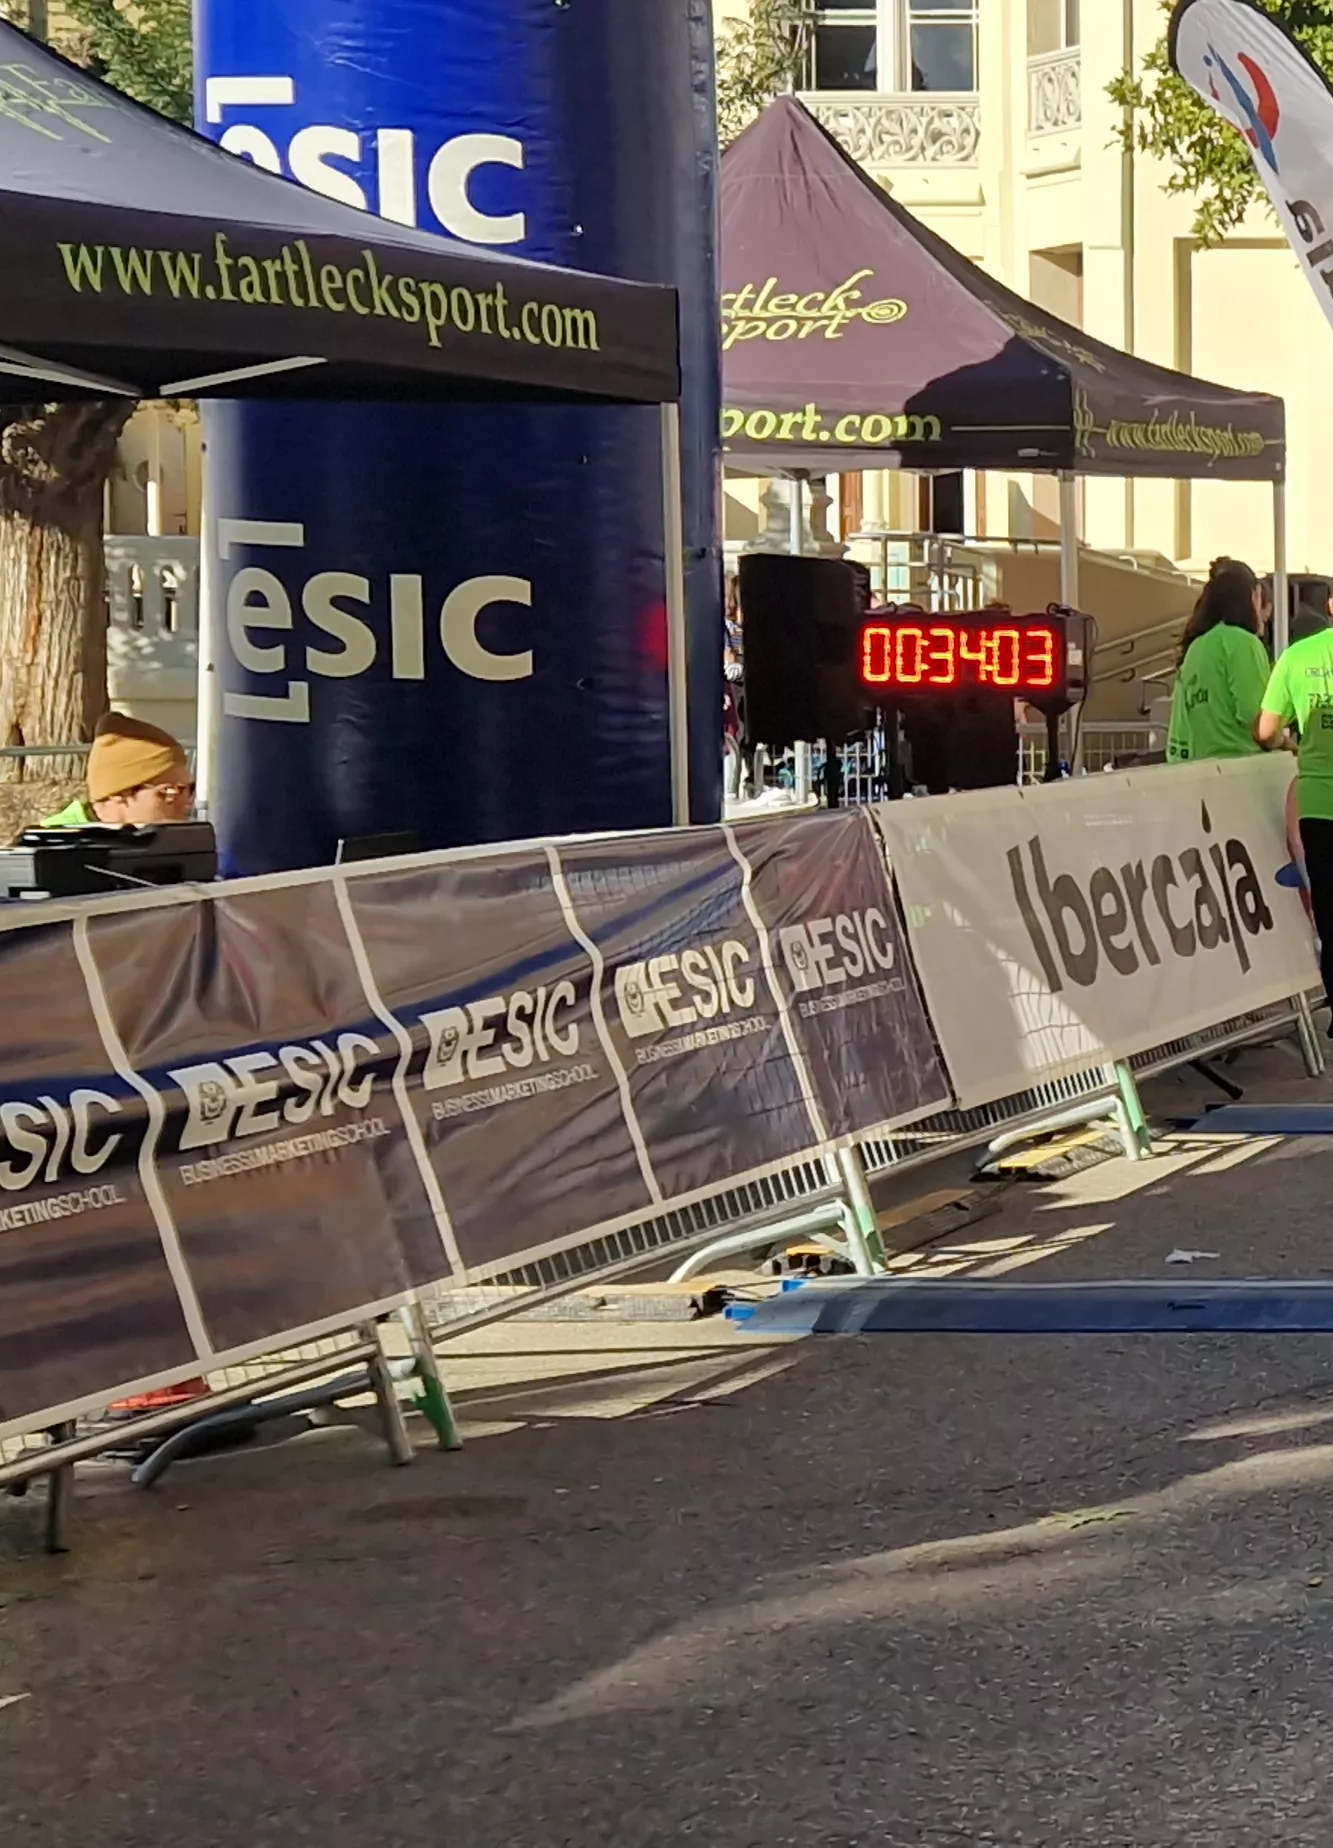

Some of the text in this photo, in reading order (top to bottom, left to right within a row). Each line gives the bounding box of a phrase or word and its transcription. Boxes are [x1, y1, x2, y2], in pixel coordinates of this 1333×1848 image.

[56, 232, 601, 350] www.fartlecksport.com
[721, 311, 850, 350] port
[1006, 799, 1274, 994] Ibercaja
[648, 940, 755, 1028] ESIC
[806, 907, 895, 985] ESIC
[465, 980, 579, 1080] ESIC
[222, 1032, 382, 1138] ESIC
[0, 1184, 127, 1233] KETINGSCHOOL
